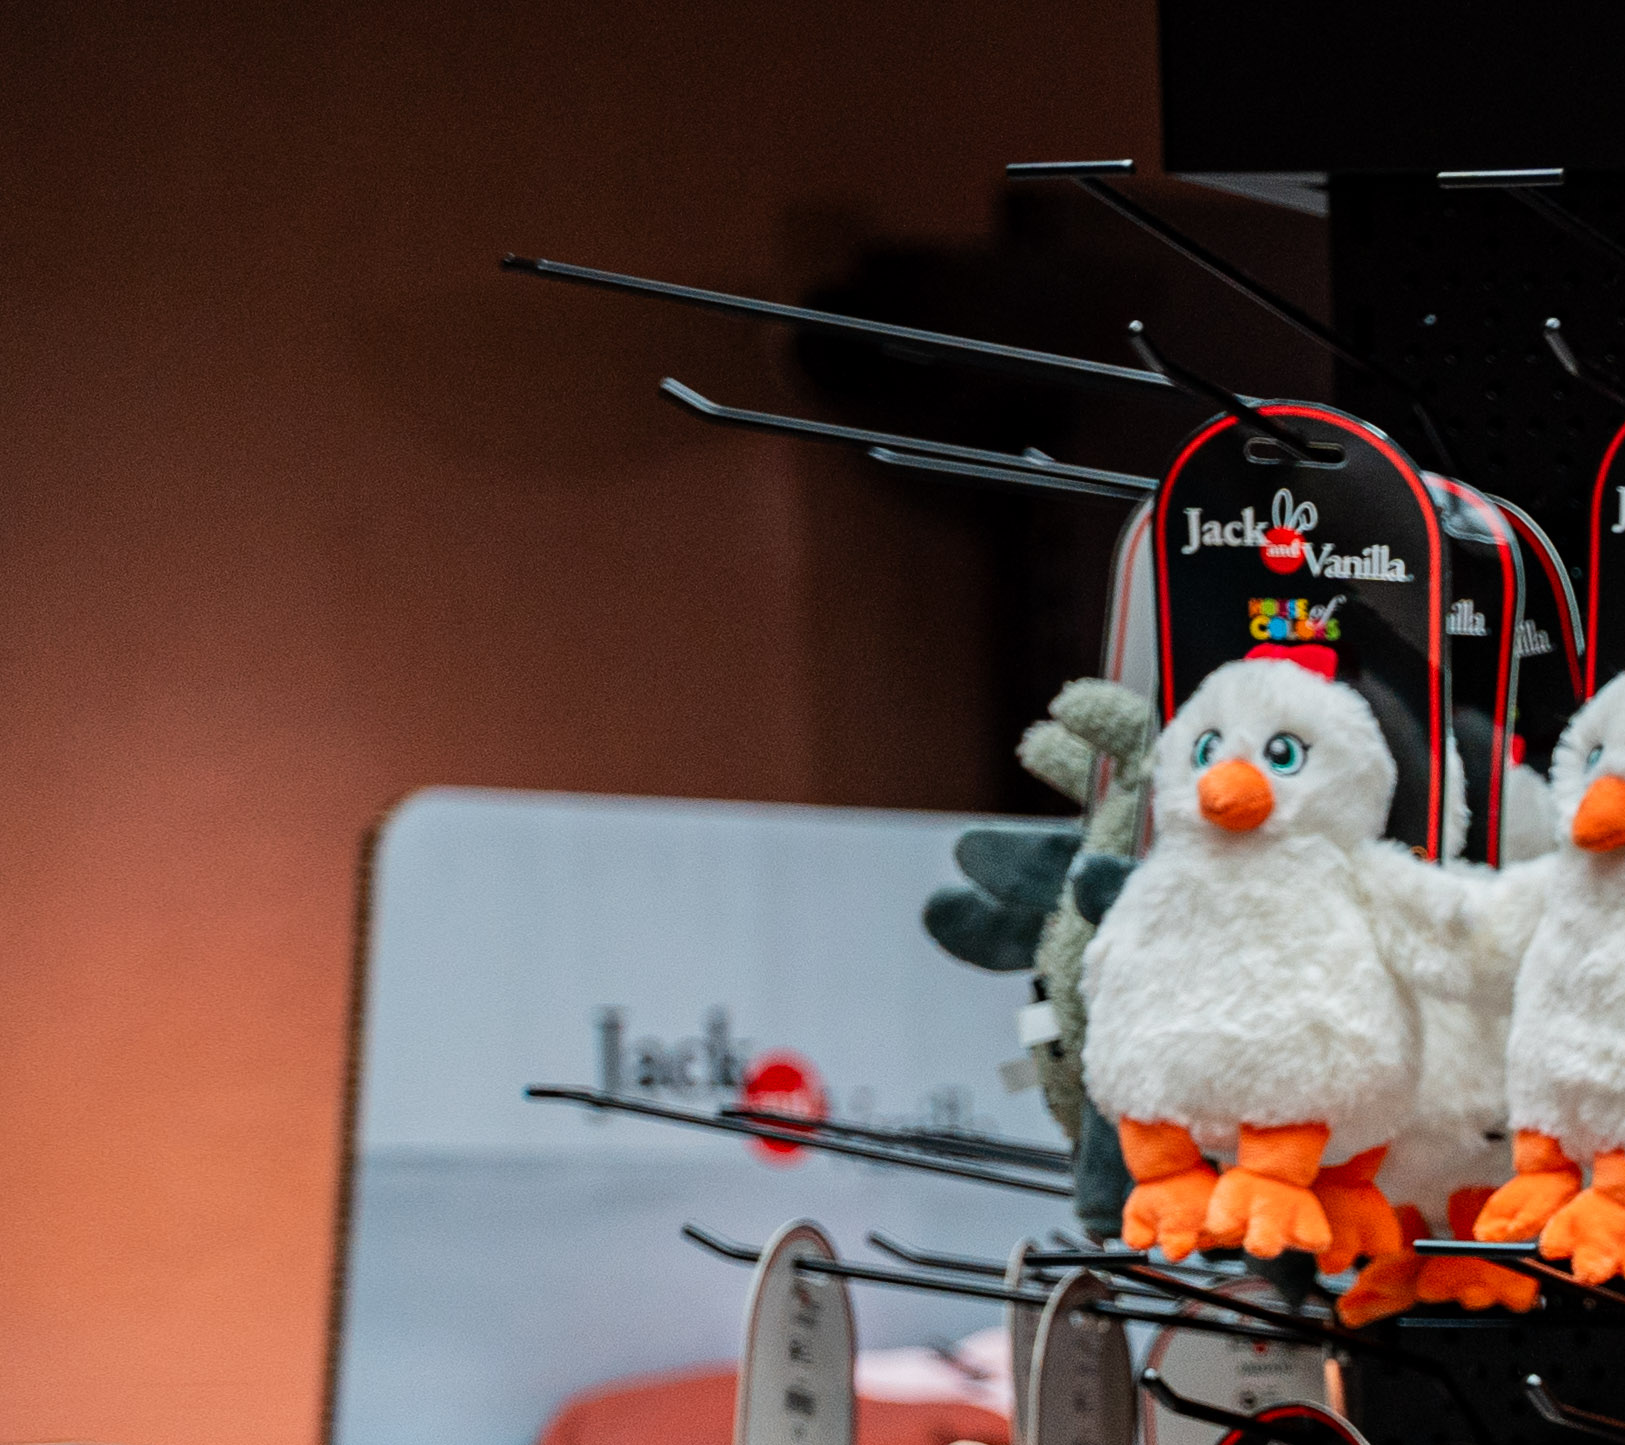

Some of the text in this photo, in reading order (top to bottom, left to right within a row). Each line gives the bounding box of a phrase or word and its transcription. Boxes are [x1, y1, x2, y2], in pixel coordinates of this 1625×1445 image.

[1181, 506, 1409, 583] Jack and Vanilla
